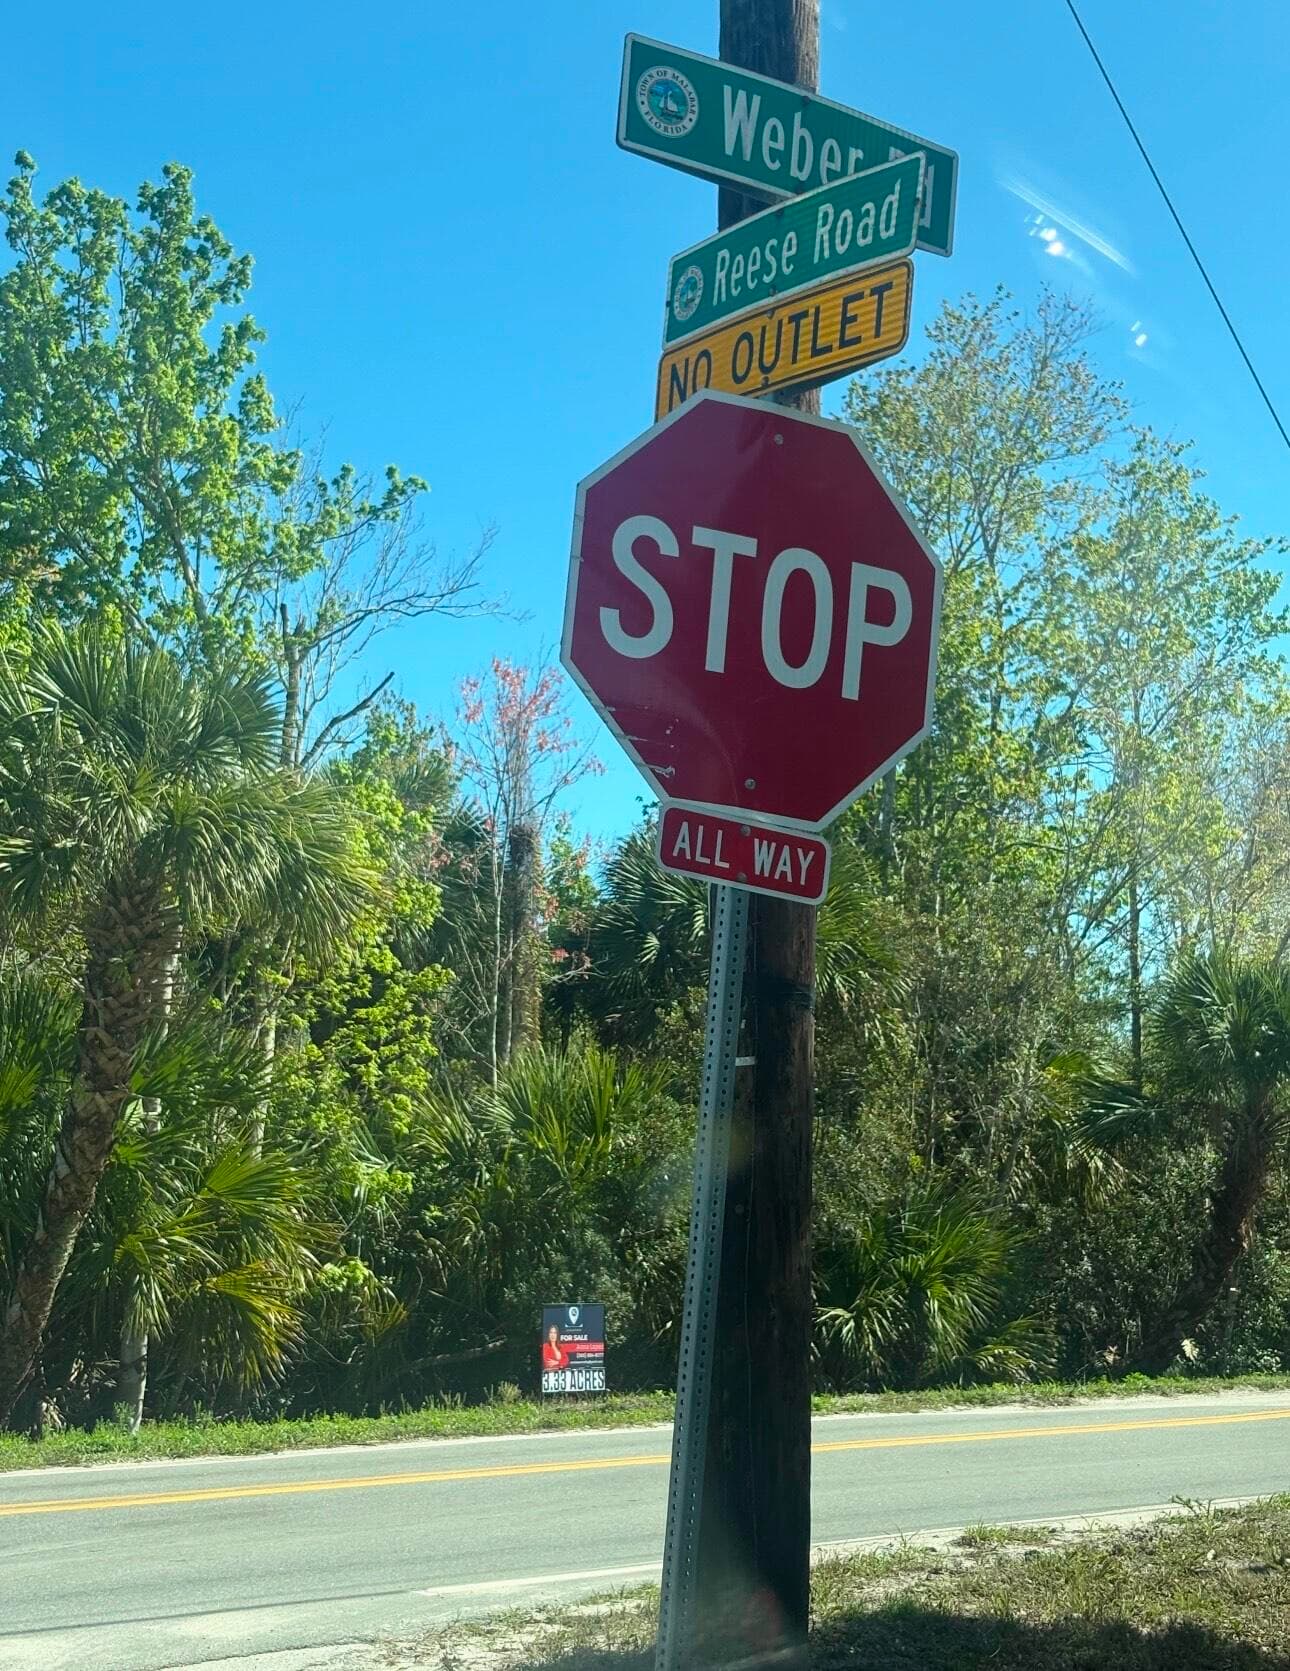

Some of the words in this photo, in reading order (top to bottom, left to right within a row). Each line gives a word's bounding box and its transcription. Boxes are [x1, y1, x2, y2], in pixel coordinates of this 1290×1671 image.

[640, 72, 655, 96] TOWN
[656, 70, 668, 78] OF
[644, 110, 688, 134] FLORIDA
[723, 85, 864, 184] Weber
[713, 231, 797, 306] Reese
[814, 178, 901, 264] Road
[668, 350, 712, 413] NO
[731, 282, 893, 385] OUTLET
[599, 514, 913, 701] STOP
[672, 821, 729, 869] ALL
[753, 838, 815, 886] WAY
[543, 1371, 567, 1391] 3.33
[569, 1369, 605, 1390] ACRES
